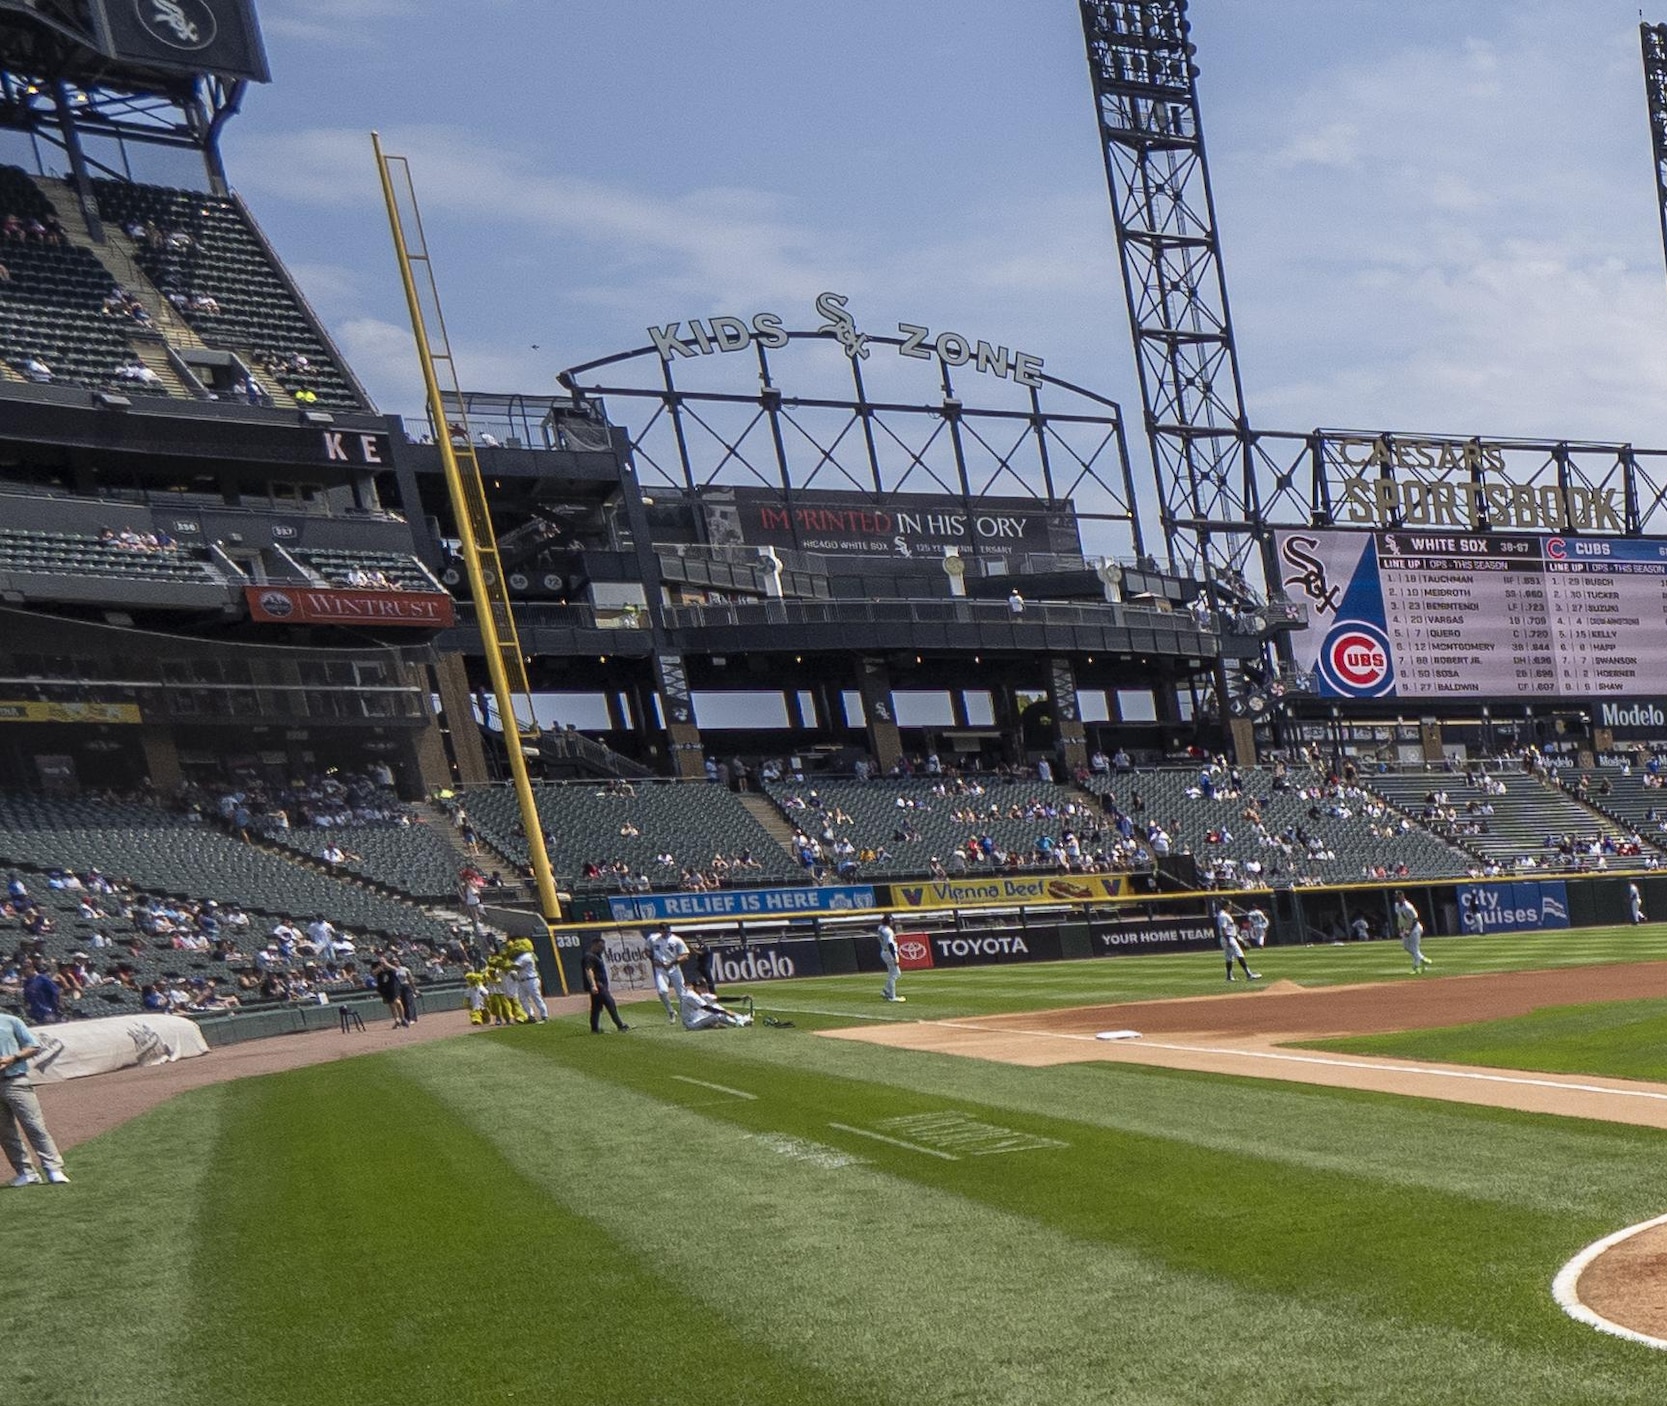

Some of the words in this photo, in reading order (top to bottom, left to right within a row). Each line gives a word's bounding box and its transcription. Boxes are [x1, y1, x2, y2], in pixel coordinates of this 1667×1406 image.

[647, 313, 789, 361] KIDS
[899, 322, 1044, 388] ZONE
[1340, 440, 1506, 472] CAESARS
[1345, 478, 1626, 533] SPORTSBOOK
[897, 513, 921, 534] IN
[840, 542, 867, 550] WHITE
[1411, 538, 1456, 551] WHITE
[1460, 540, 1488, 552] SOX
[1575, 543, 1610, 555] CUBS
[1384, 560, 1405, 568] LINE
[1408, 561, 1420, 569] UP
[1550, 562, 1569, 570] LINE
[1572, 563, 1583, 571] UP
[1587, 592, 1619, 600] TUCKER
[308, 593, 439, 617] WINTRUST
[1431, 643, 1495, 651] MONTGOMERY
[1438, 683, 1479, 691] BALDWIN
[1602, 703, 1664, 727] Modelo
[1600, 755, 1630, 767] Modelo
[932, 882, 1000, 901] Vienna
[1003, 880, 1045, 897] Beef
[665, 899, 734, 914] RELIEF
[741, 896, 760, 910] IS
[766, 893, 819, 909] HERE
[557, 936, 580, 947] 330
[1102, 931, 1138, 945] YOUR
[1140, 930, 1177, 943] HOME
[1180, 927, 1214, 941] TEAM
[937, 937, 1028, 957] TOYOTA
